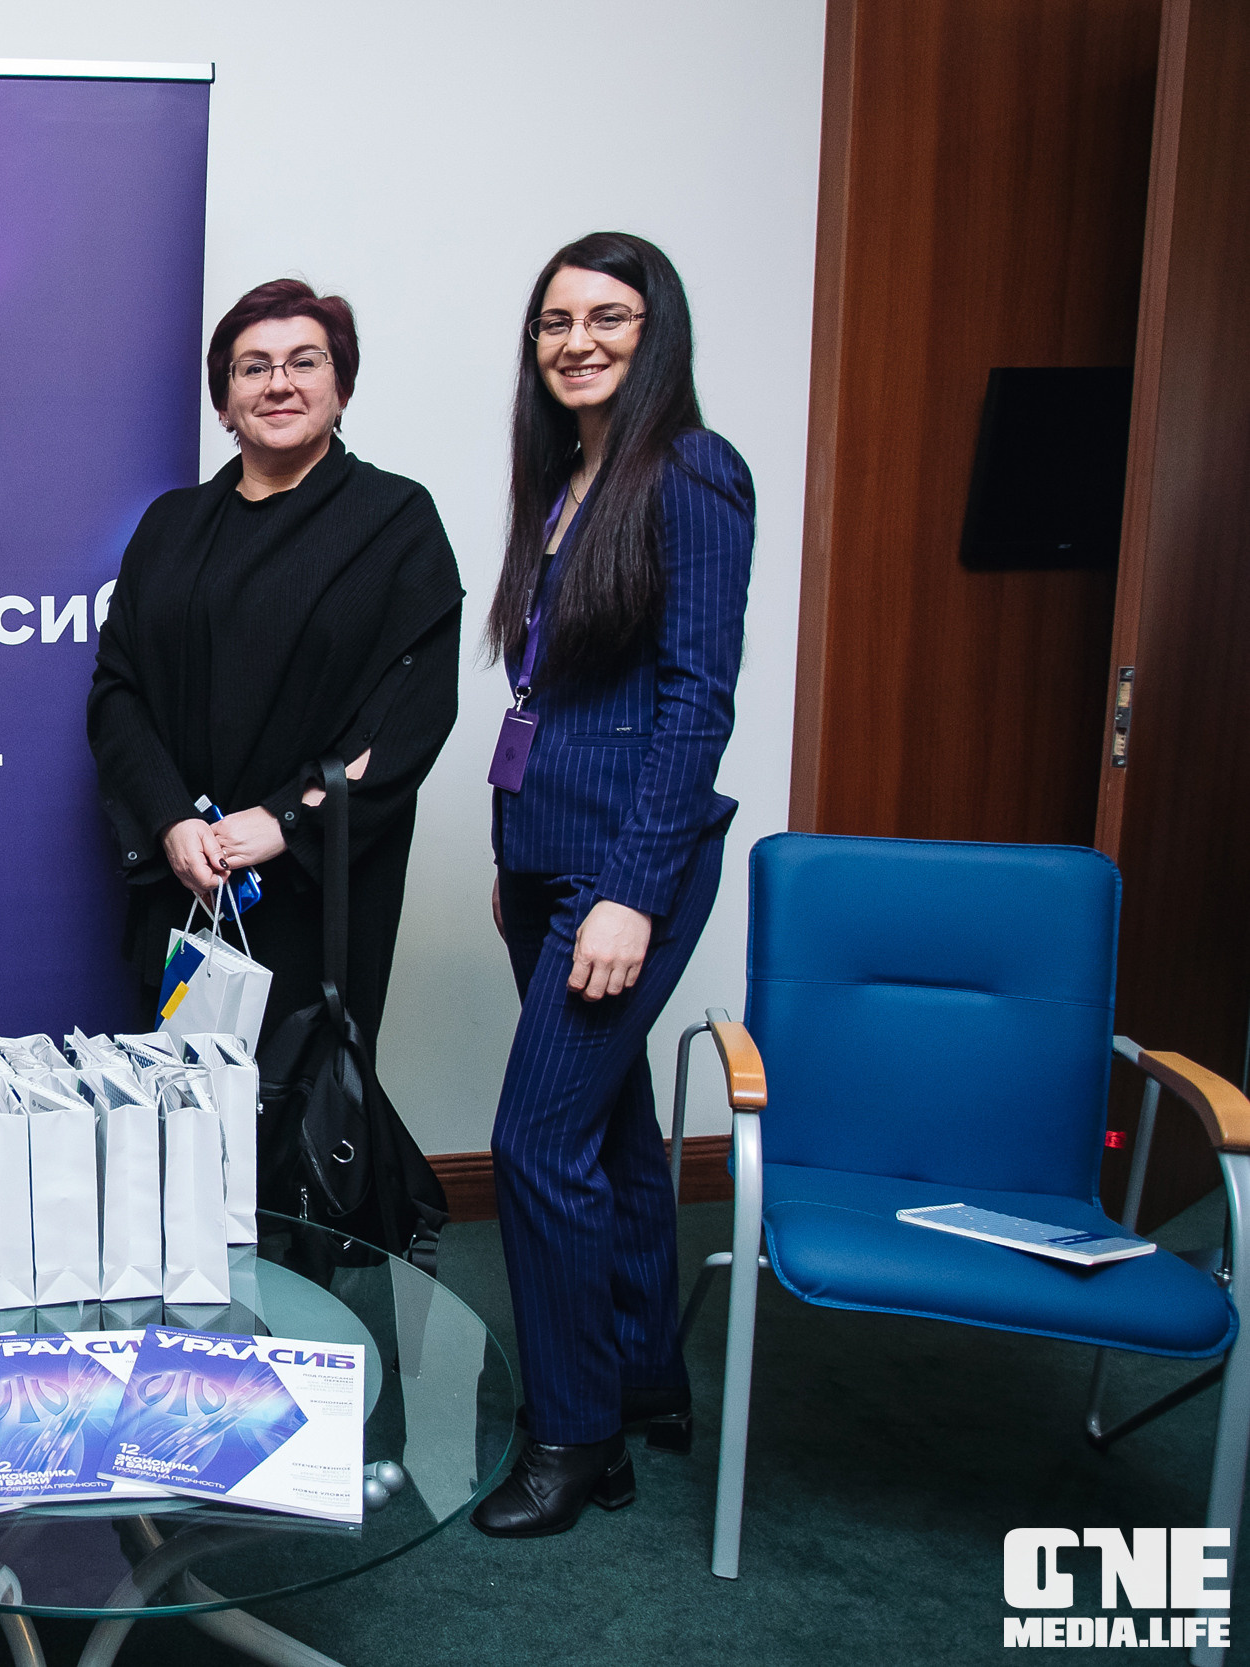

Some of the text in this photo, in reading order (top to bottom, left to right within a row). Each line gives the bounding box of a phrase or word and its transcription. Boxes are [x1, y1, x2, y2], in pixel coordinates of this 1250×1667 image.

[119, 1442, 140, 1456] 12
[114, 1459, 170, 1474] И БАНКИ
[116, 1454, 199, 1473] ЭКОНОМИКА
[5, 1477, 50, 1486] БАНКИ
[112, 1465, 157, 1478] ПРОВЕРКА
[171, 1475, 226, 1489] ПРОЧНОСТЬ
[53, 1481, 108, 1489] ПРОЧНОСТЬ
